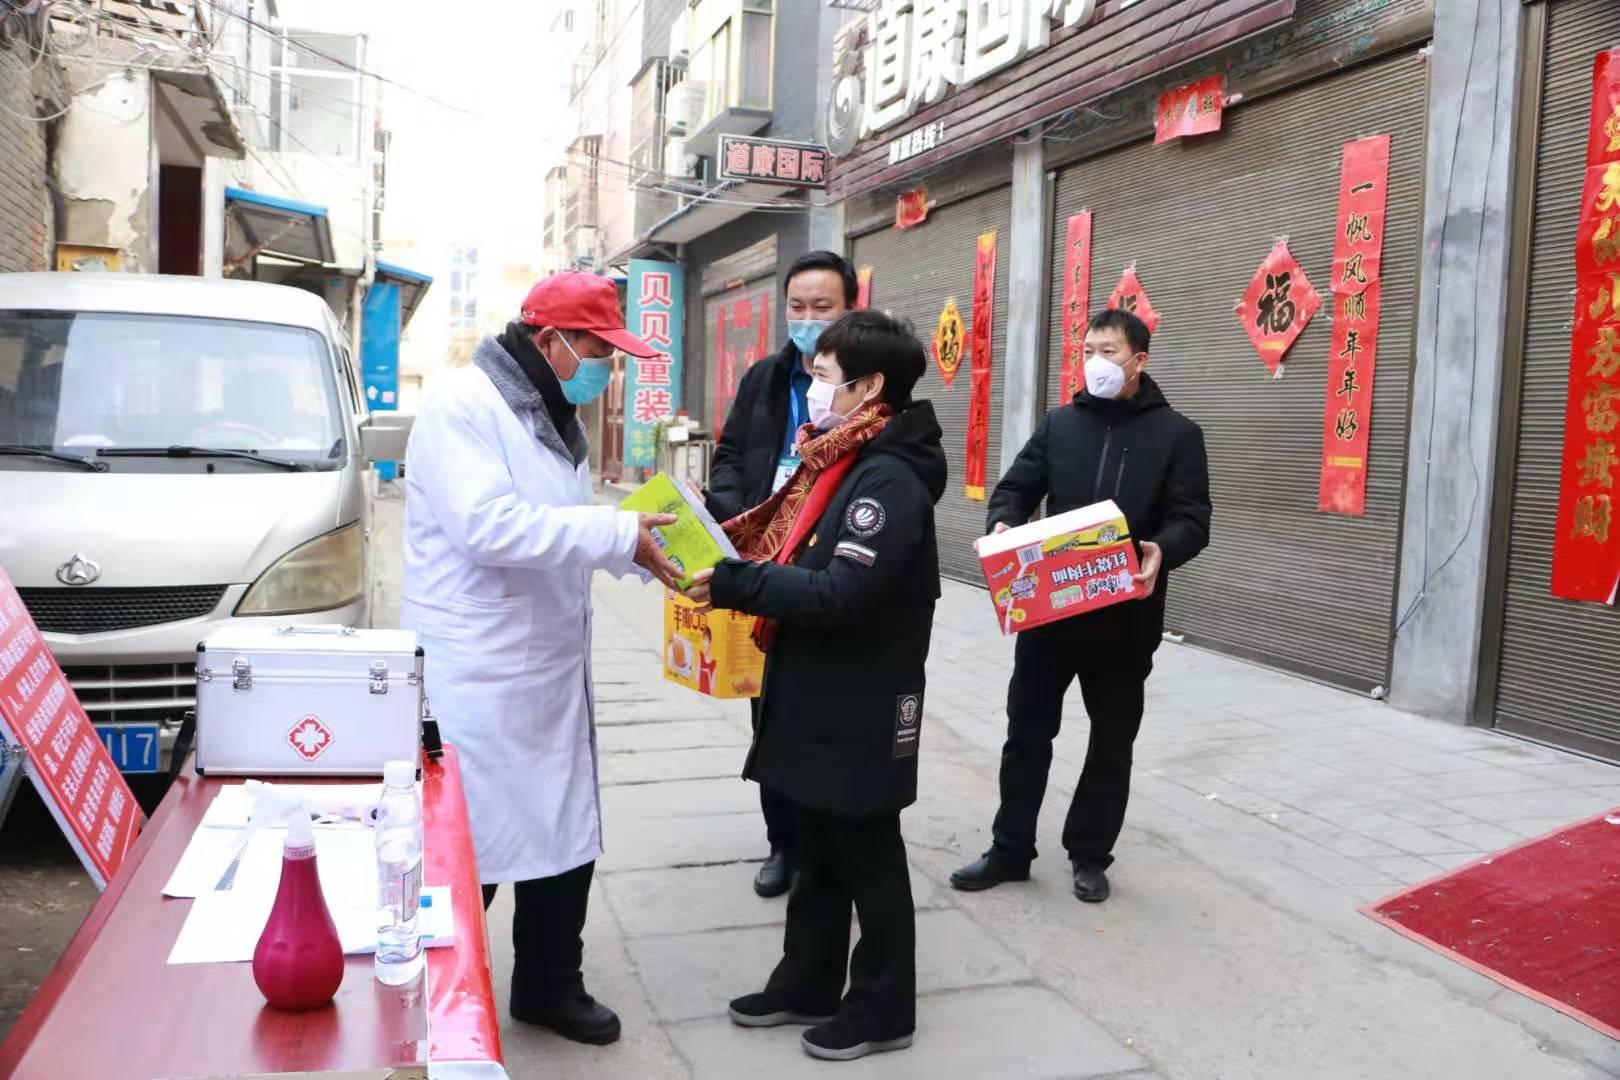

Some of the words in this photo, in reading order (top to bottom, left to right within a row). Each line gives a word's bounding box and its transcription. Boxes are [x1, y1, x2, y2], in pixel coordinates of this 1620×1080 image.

[726, 142, 825, 182] 道康国际
[1256, 271, 1296, 336] 福
[1335, 182, 1374, 441] 一帆风顺年年好
[634, 272, 673, 423] 贝贝童装
[1051, 552, 1127, 586] 红烧牛肉面
